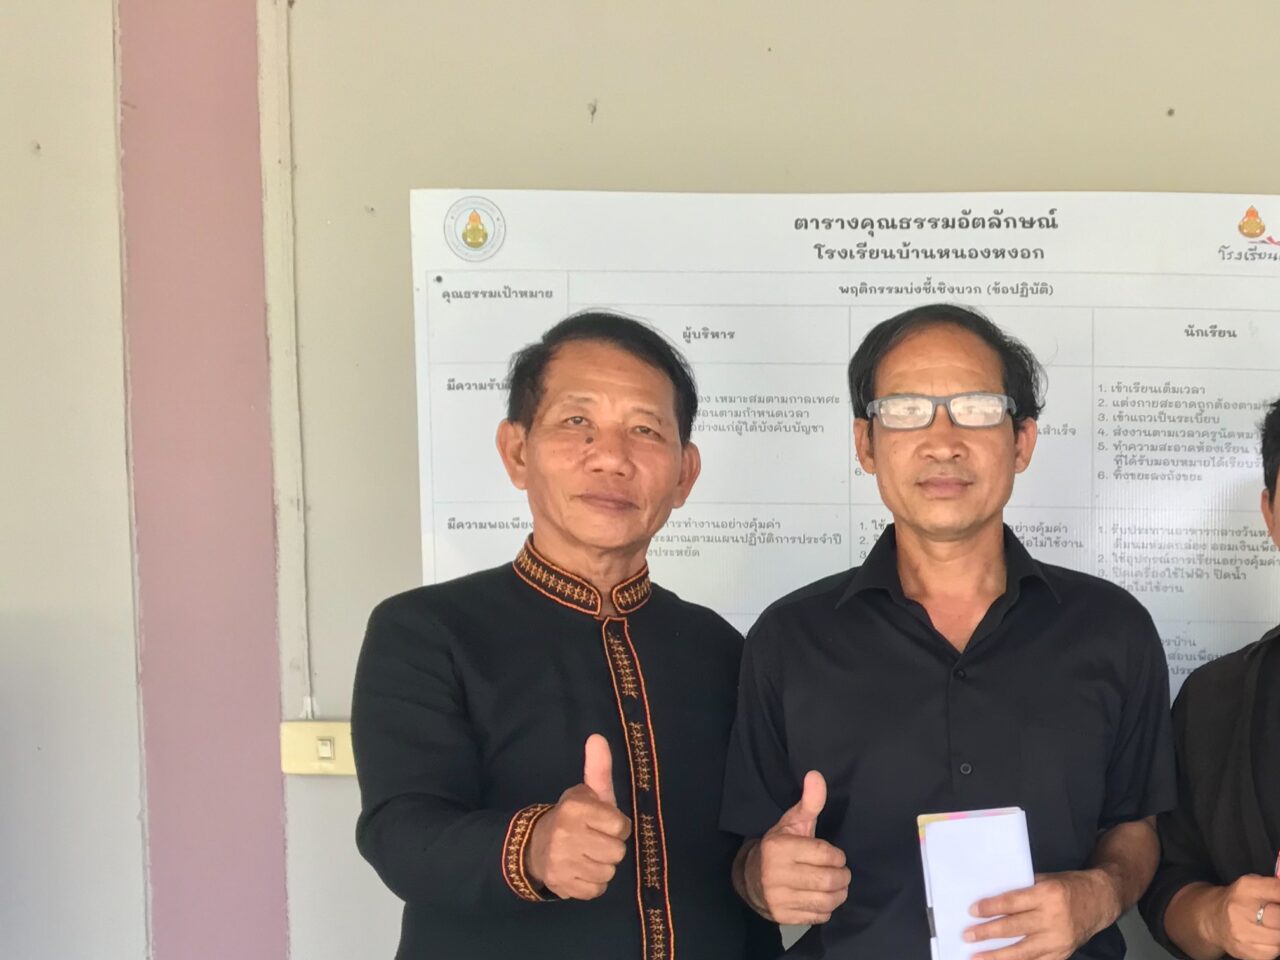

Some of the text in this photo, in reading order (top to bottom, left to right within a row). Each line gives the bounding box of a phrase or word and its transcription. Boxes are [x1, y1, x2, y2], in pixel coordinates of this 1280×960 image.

[794, 208, 1059, 238] ตารางคุณธรรมอัตลักษณ์
[813, 241, 1045, 260] โรงเรียนบ้านหนองหงอก
[442, 285, 553, 302] คุณธรรมเป้าหมาย
[839, 277, 1055, 298] พฤติกรรมบ่งชี้เชิงบวก (ข้อปฏิบัติ)
[682, 328, 736, 345] ผู้บริหาร
[1184, 325, 1237, 339] นักเรียน
[1111, 382, 1206, 395] เข้าเรียนเต็มเวลา
